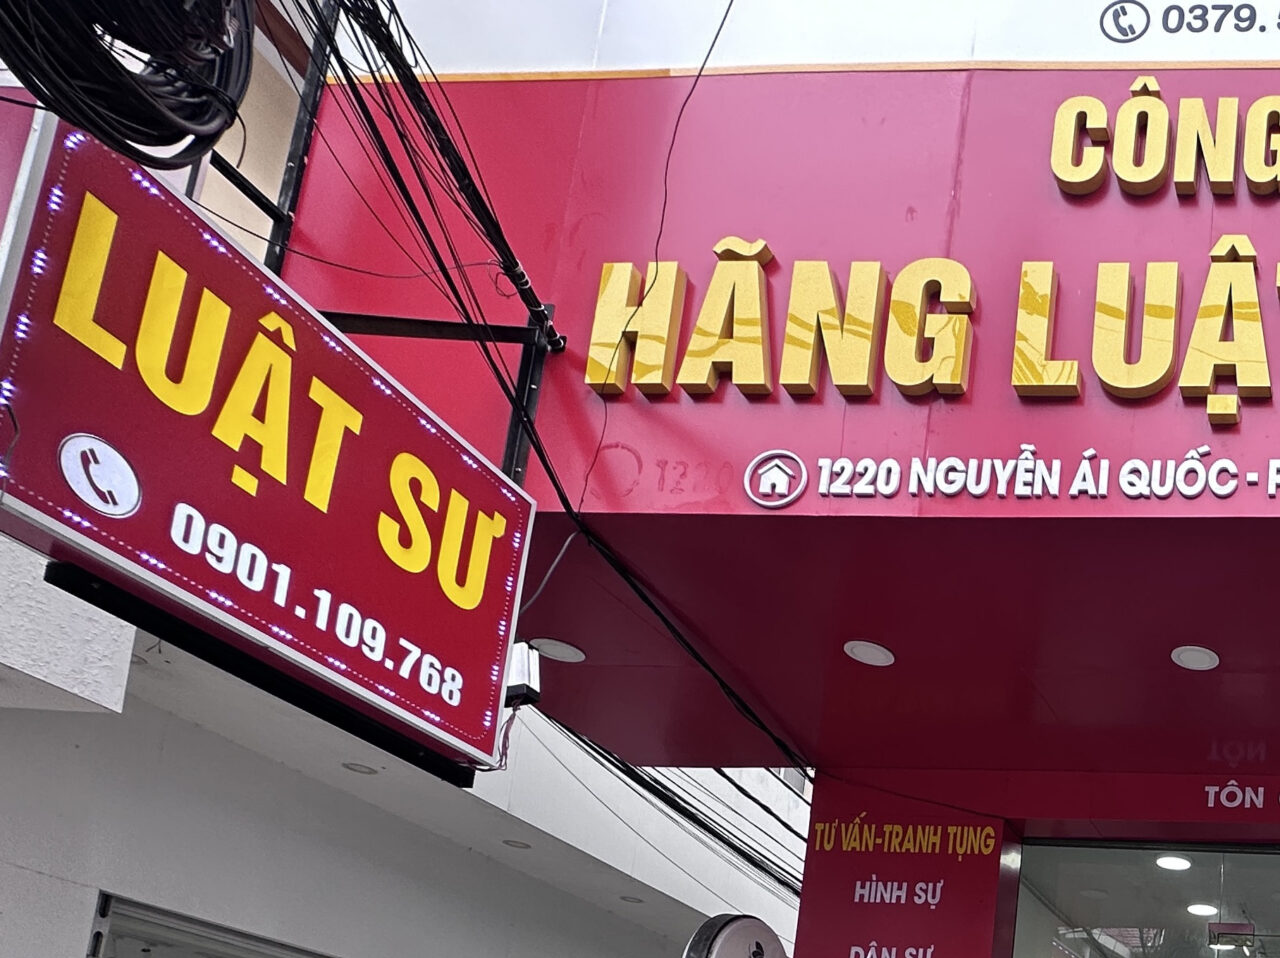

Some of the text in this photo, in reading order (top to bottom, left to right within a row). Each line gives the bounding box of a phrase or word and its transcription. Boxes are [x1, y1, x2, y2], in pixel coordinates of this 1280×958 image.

[584, 236, 975, 397] HÃNG
[53, 192, 506, 610] LUẬT SƯ
[817, 457, 900, 498] 1220
[907, 443, 1061, 498] NGUYỄN
[1069, 447, 1109, 498] ÁI
[1118, 444, 1238, 499] QUỐC
[170, 502, 464, 707] 0901.109.768
[1205, 779, 1264, 809] TÔN
[814, 819, 838, 851] TƯ
[947, 825, 995, 861] TỤNG
[854, 874, 944, 909] HÌNH SỰ
